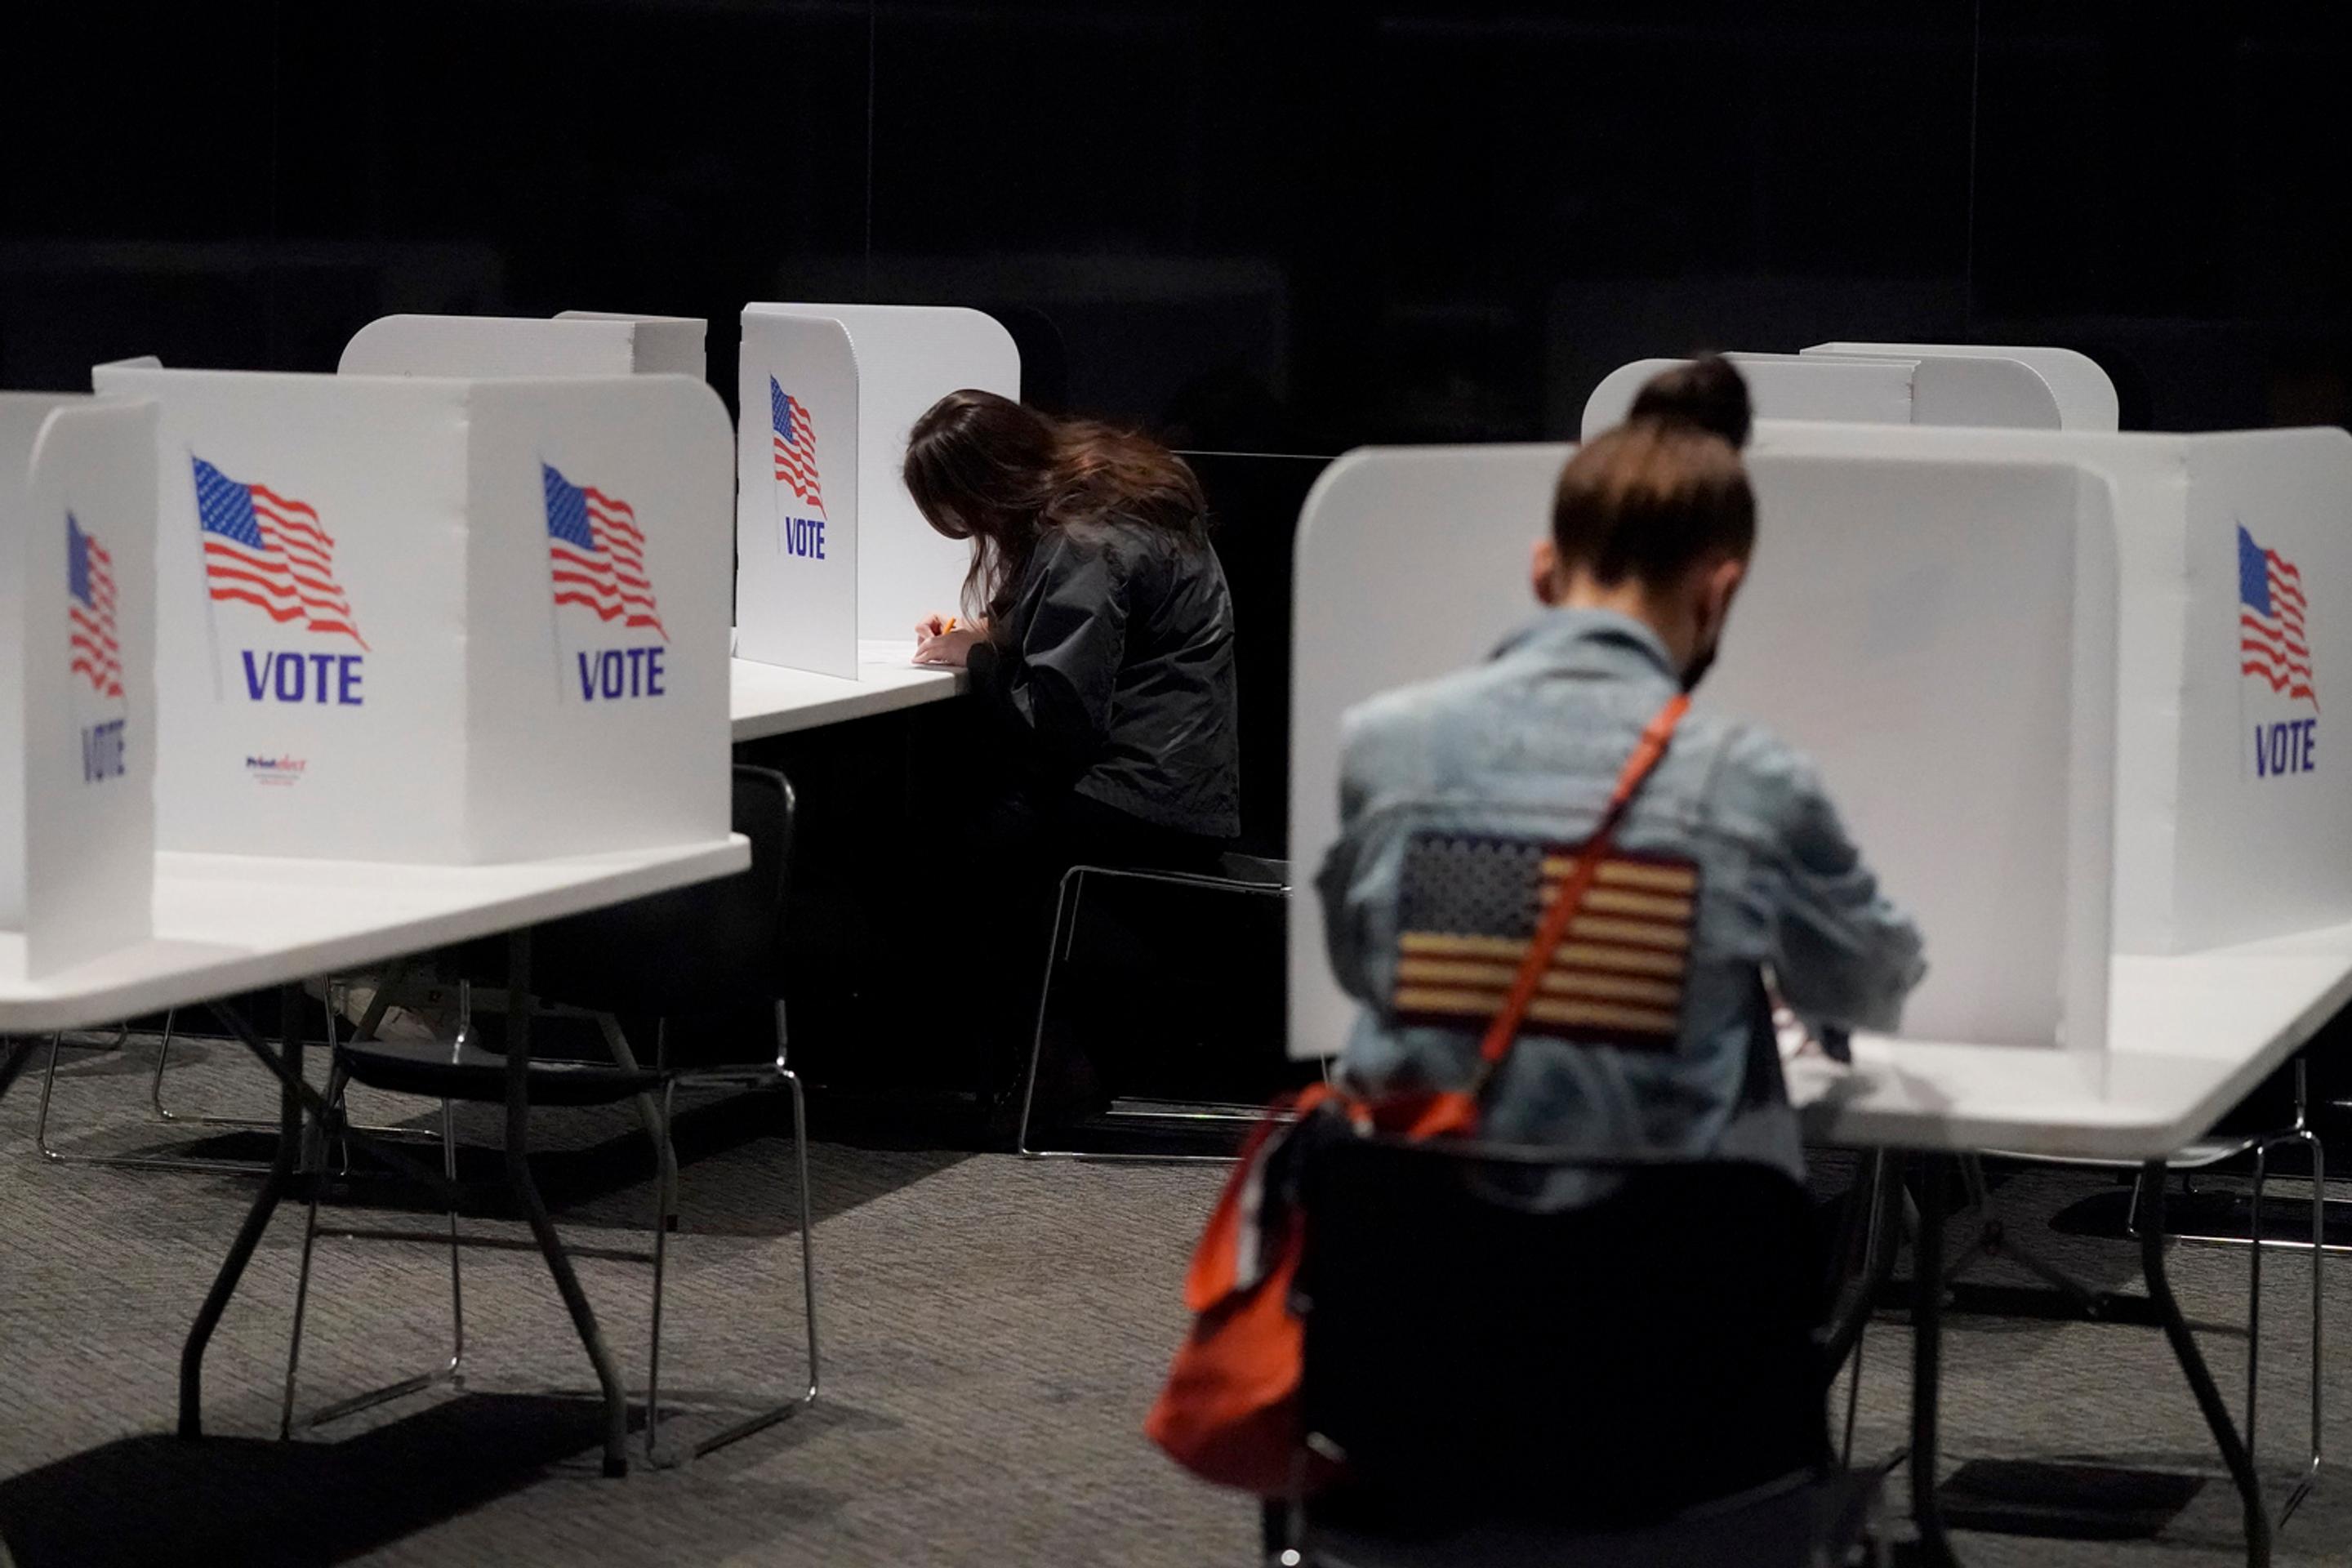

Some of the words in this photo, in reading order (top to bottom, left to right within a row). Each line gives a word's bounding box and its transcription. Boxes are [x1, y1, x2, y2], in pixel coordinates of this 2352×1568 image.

[786, 516, 825, 559] VOTE
[242, 650, 363, 706] VOTE
[577, 646, 666, 702] VOTE
[2256, 719, 2317, 777] VOTE
